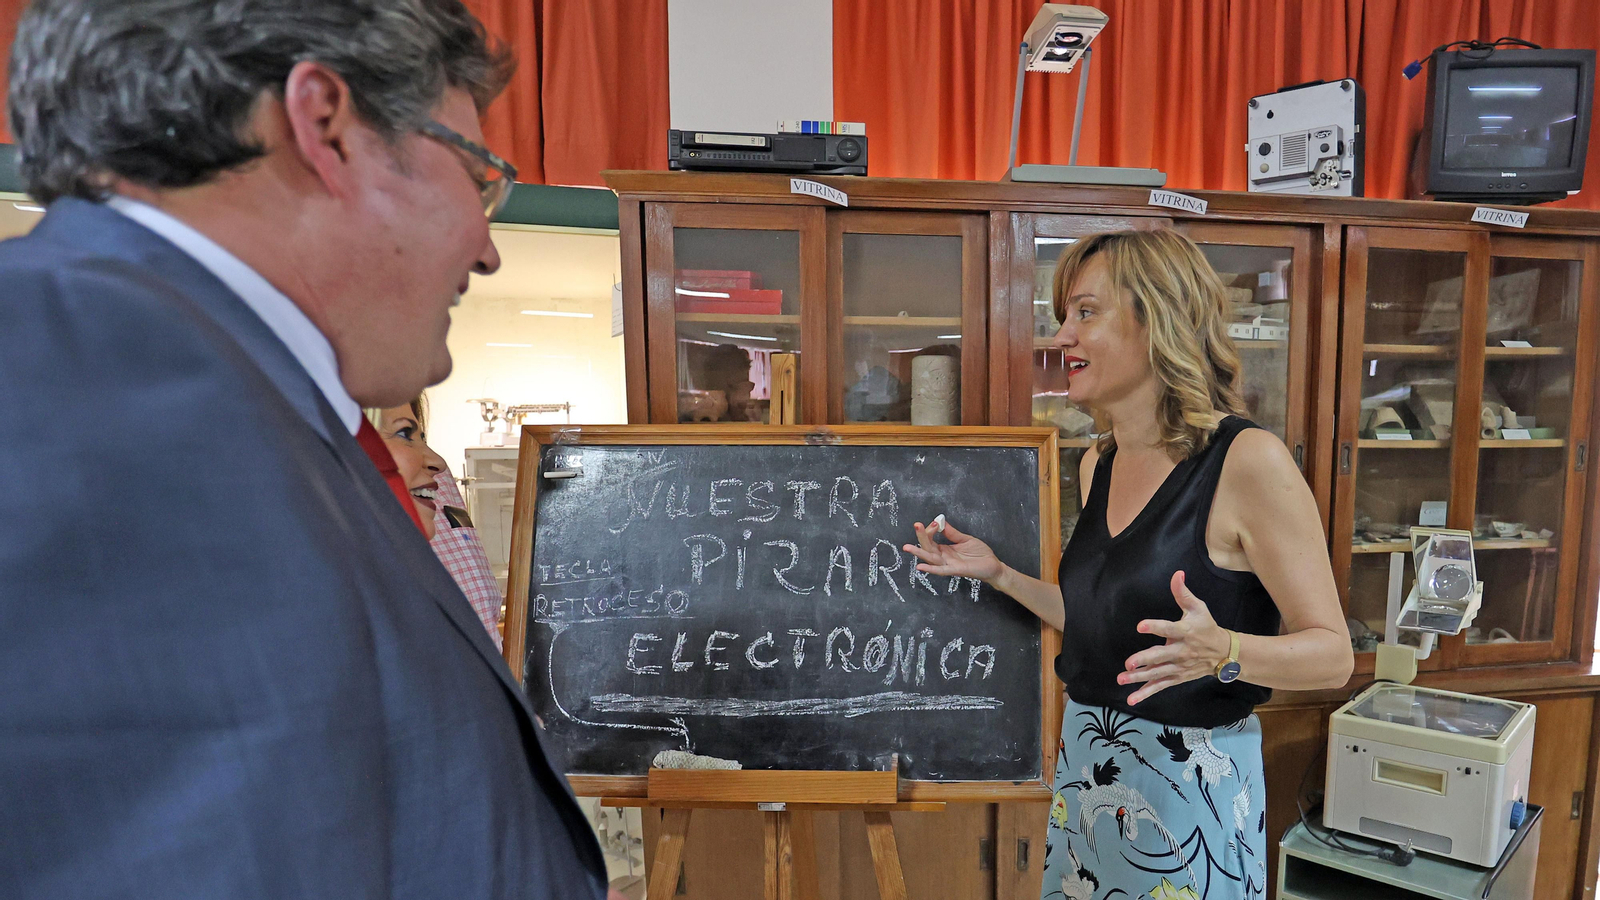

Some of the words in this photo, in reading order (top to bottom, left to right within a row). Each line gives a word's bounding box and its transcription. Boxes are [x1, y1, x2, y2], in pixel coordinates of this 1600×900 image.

[793, 180, 845, 203] VITRINA
[1152, 193, 1204, 212] VITRINA
[1476, 210, 1525, 225] VITRINA
[538, 559, 612, 583] TECLA
[533, 585, 690, 618] RETROCESO
